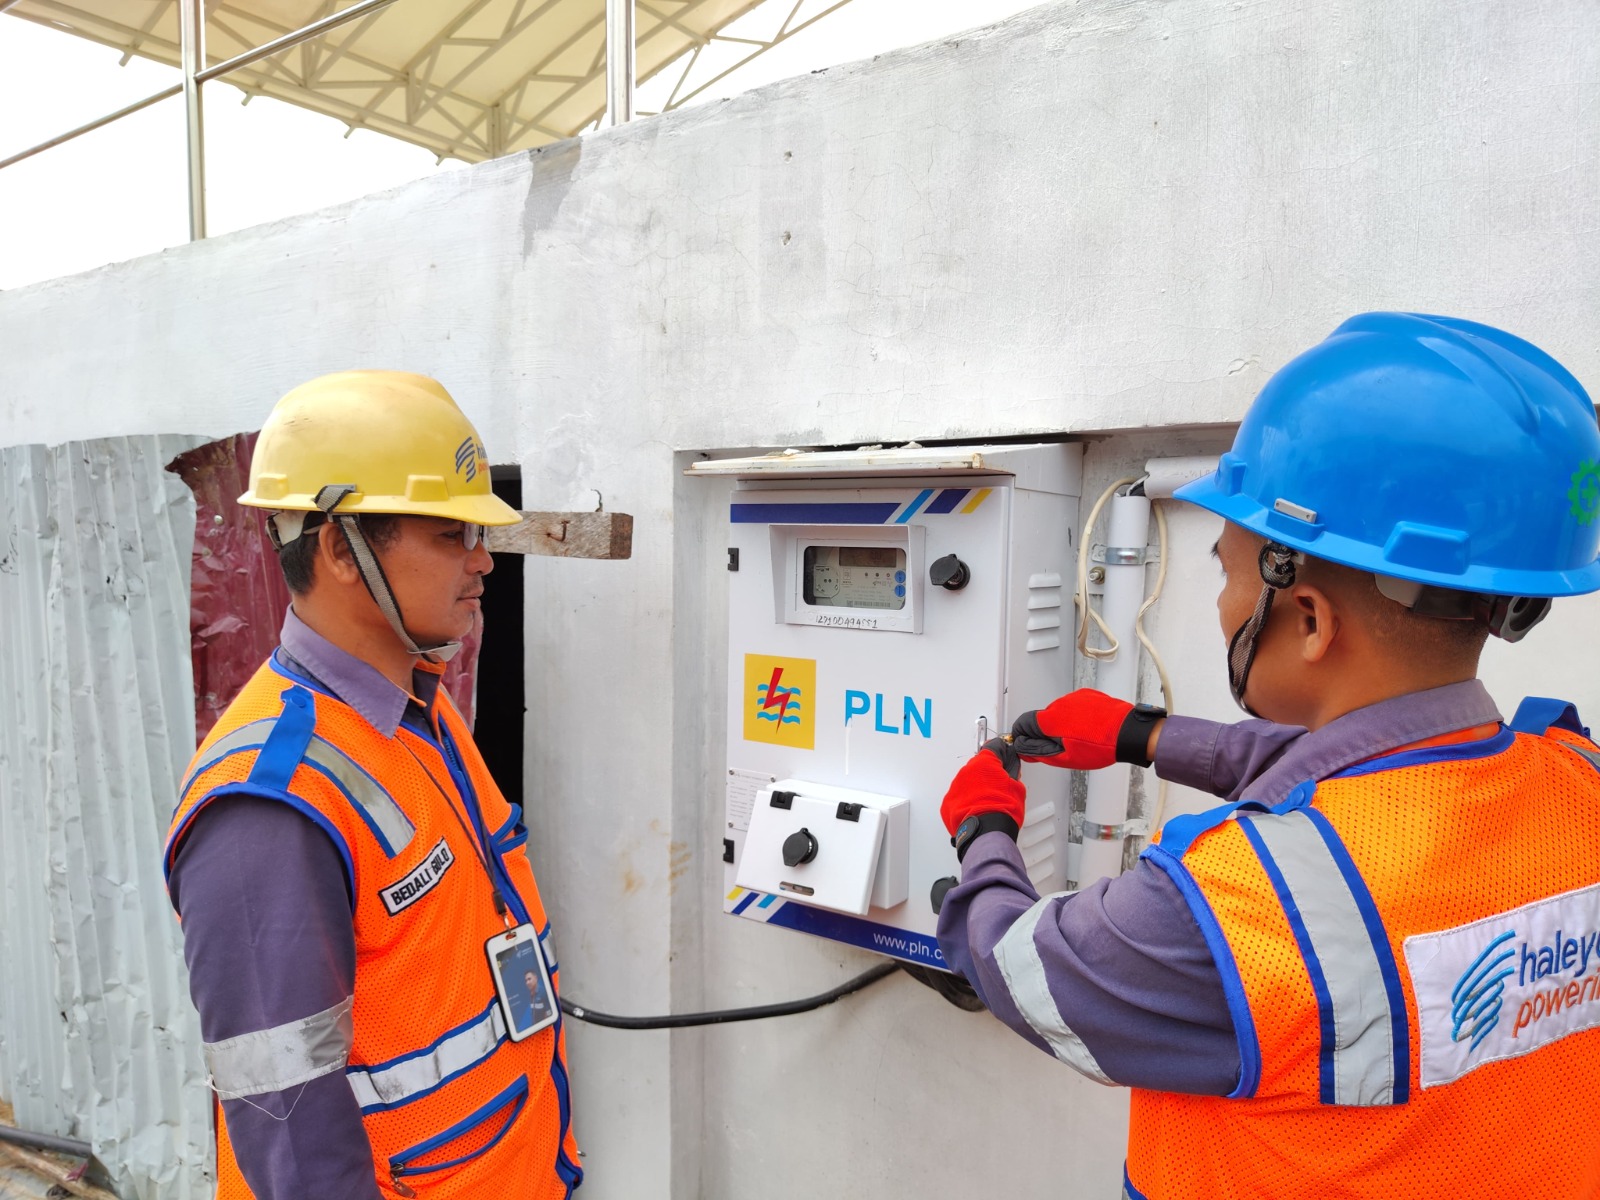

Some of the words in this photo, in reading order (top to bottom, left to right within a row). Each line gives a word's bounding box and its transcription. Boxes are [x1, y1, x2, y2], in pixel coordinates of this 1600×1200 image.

[845, 689, 932, 739] PLN
[390, 868, 433, 906] BEDALI
[873, 932, 945, 961] www.pln.c
